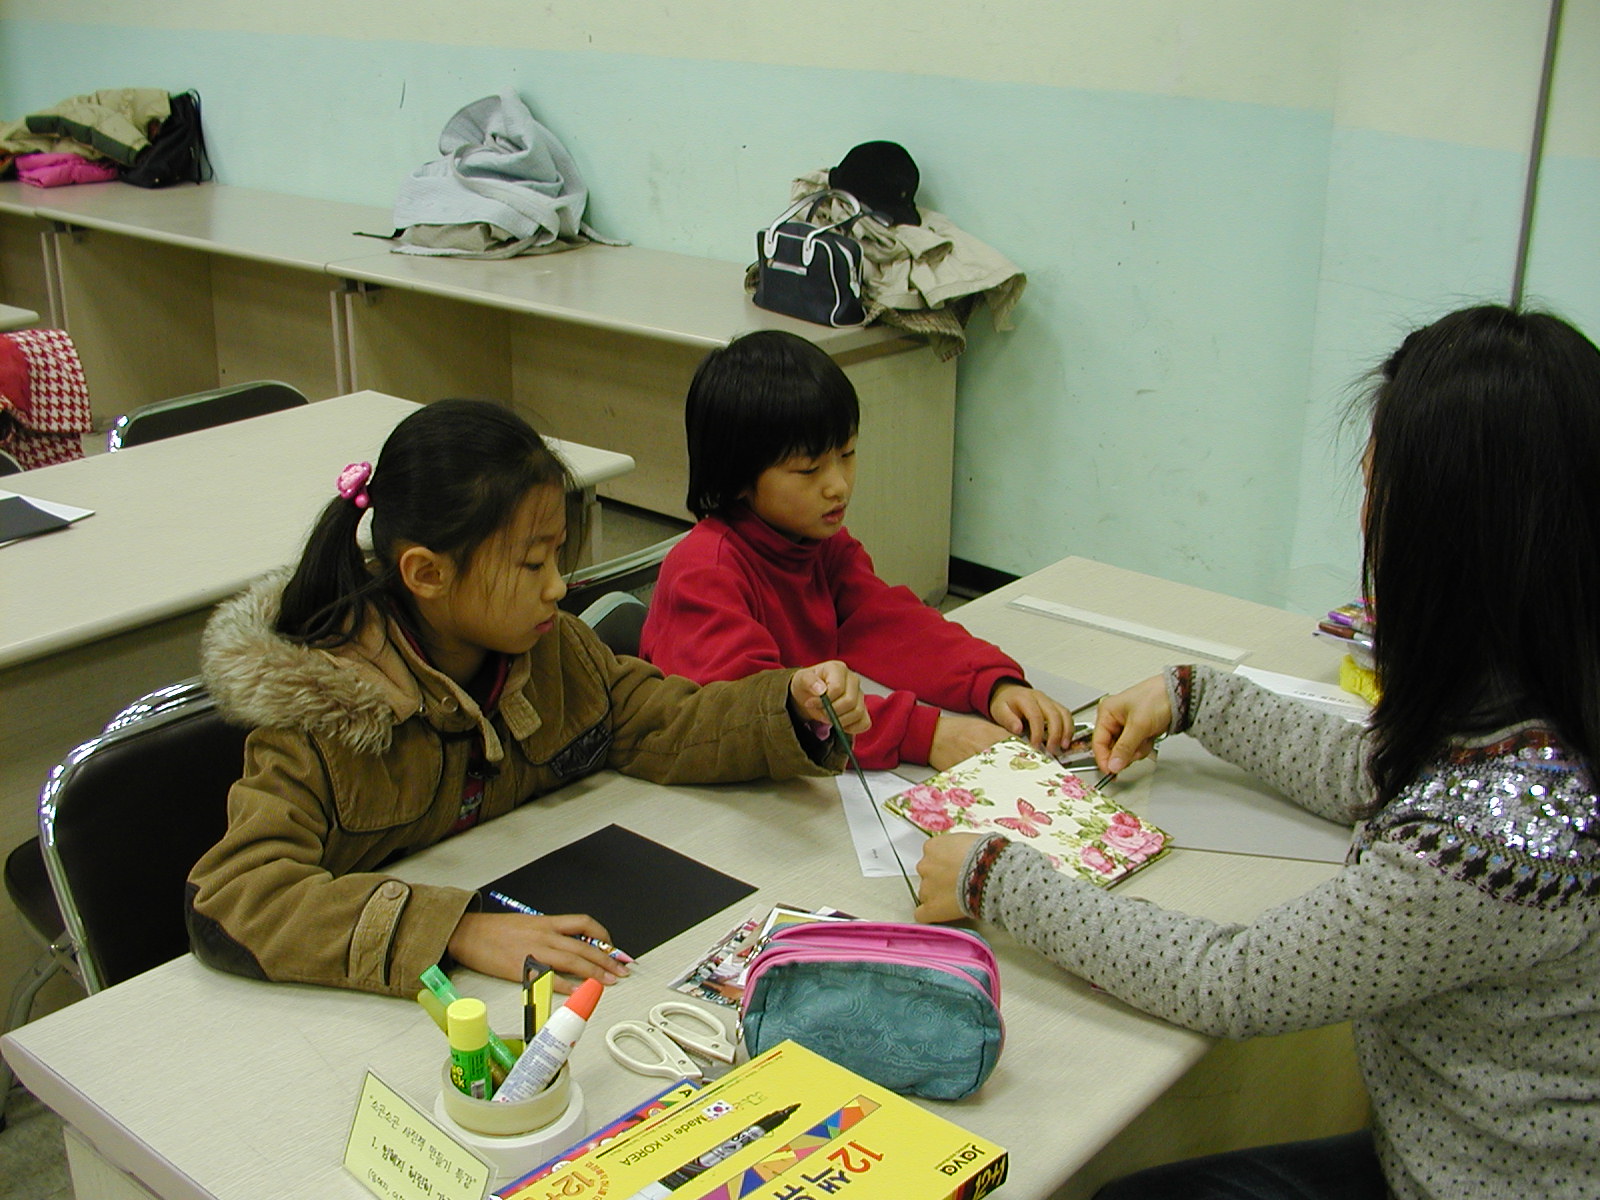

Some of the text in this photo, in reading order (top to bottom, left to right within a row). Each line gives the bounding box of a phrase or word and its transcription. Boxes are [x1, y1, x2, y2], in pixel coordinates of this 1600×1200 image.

[619, 1115, 708, 1166] Made in KOREA
[940, 1145, 986, 1176] Java
